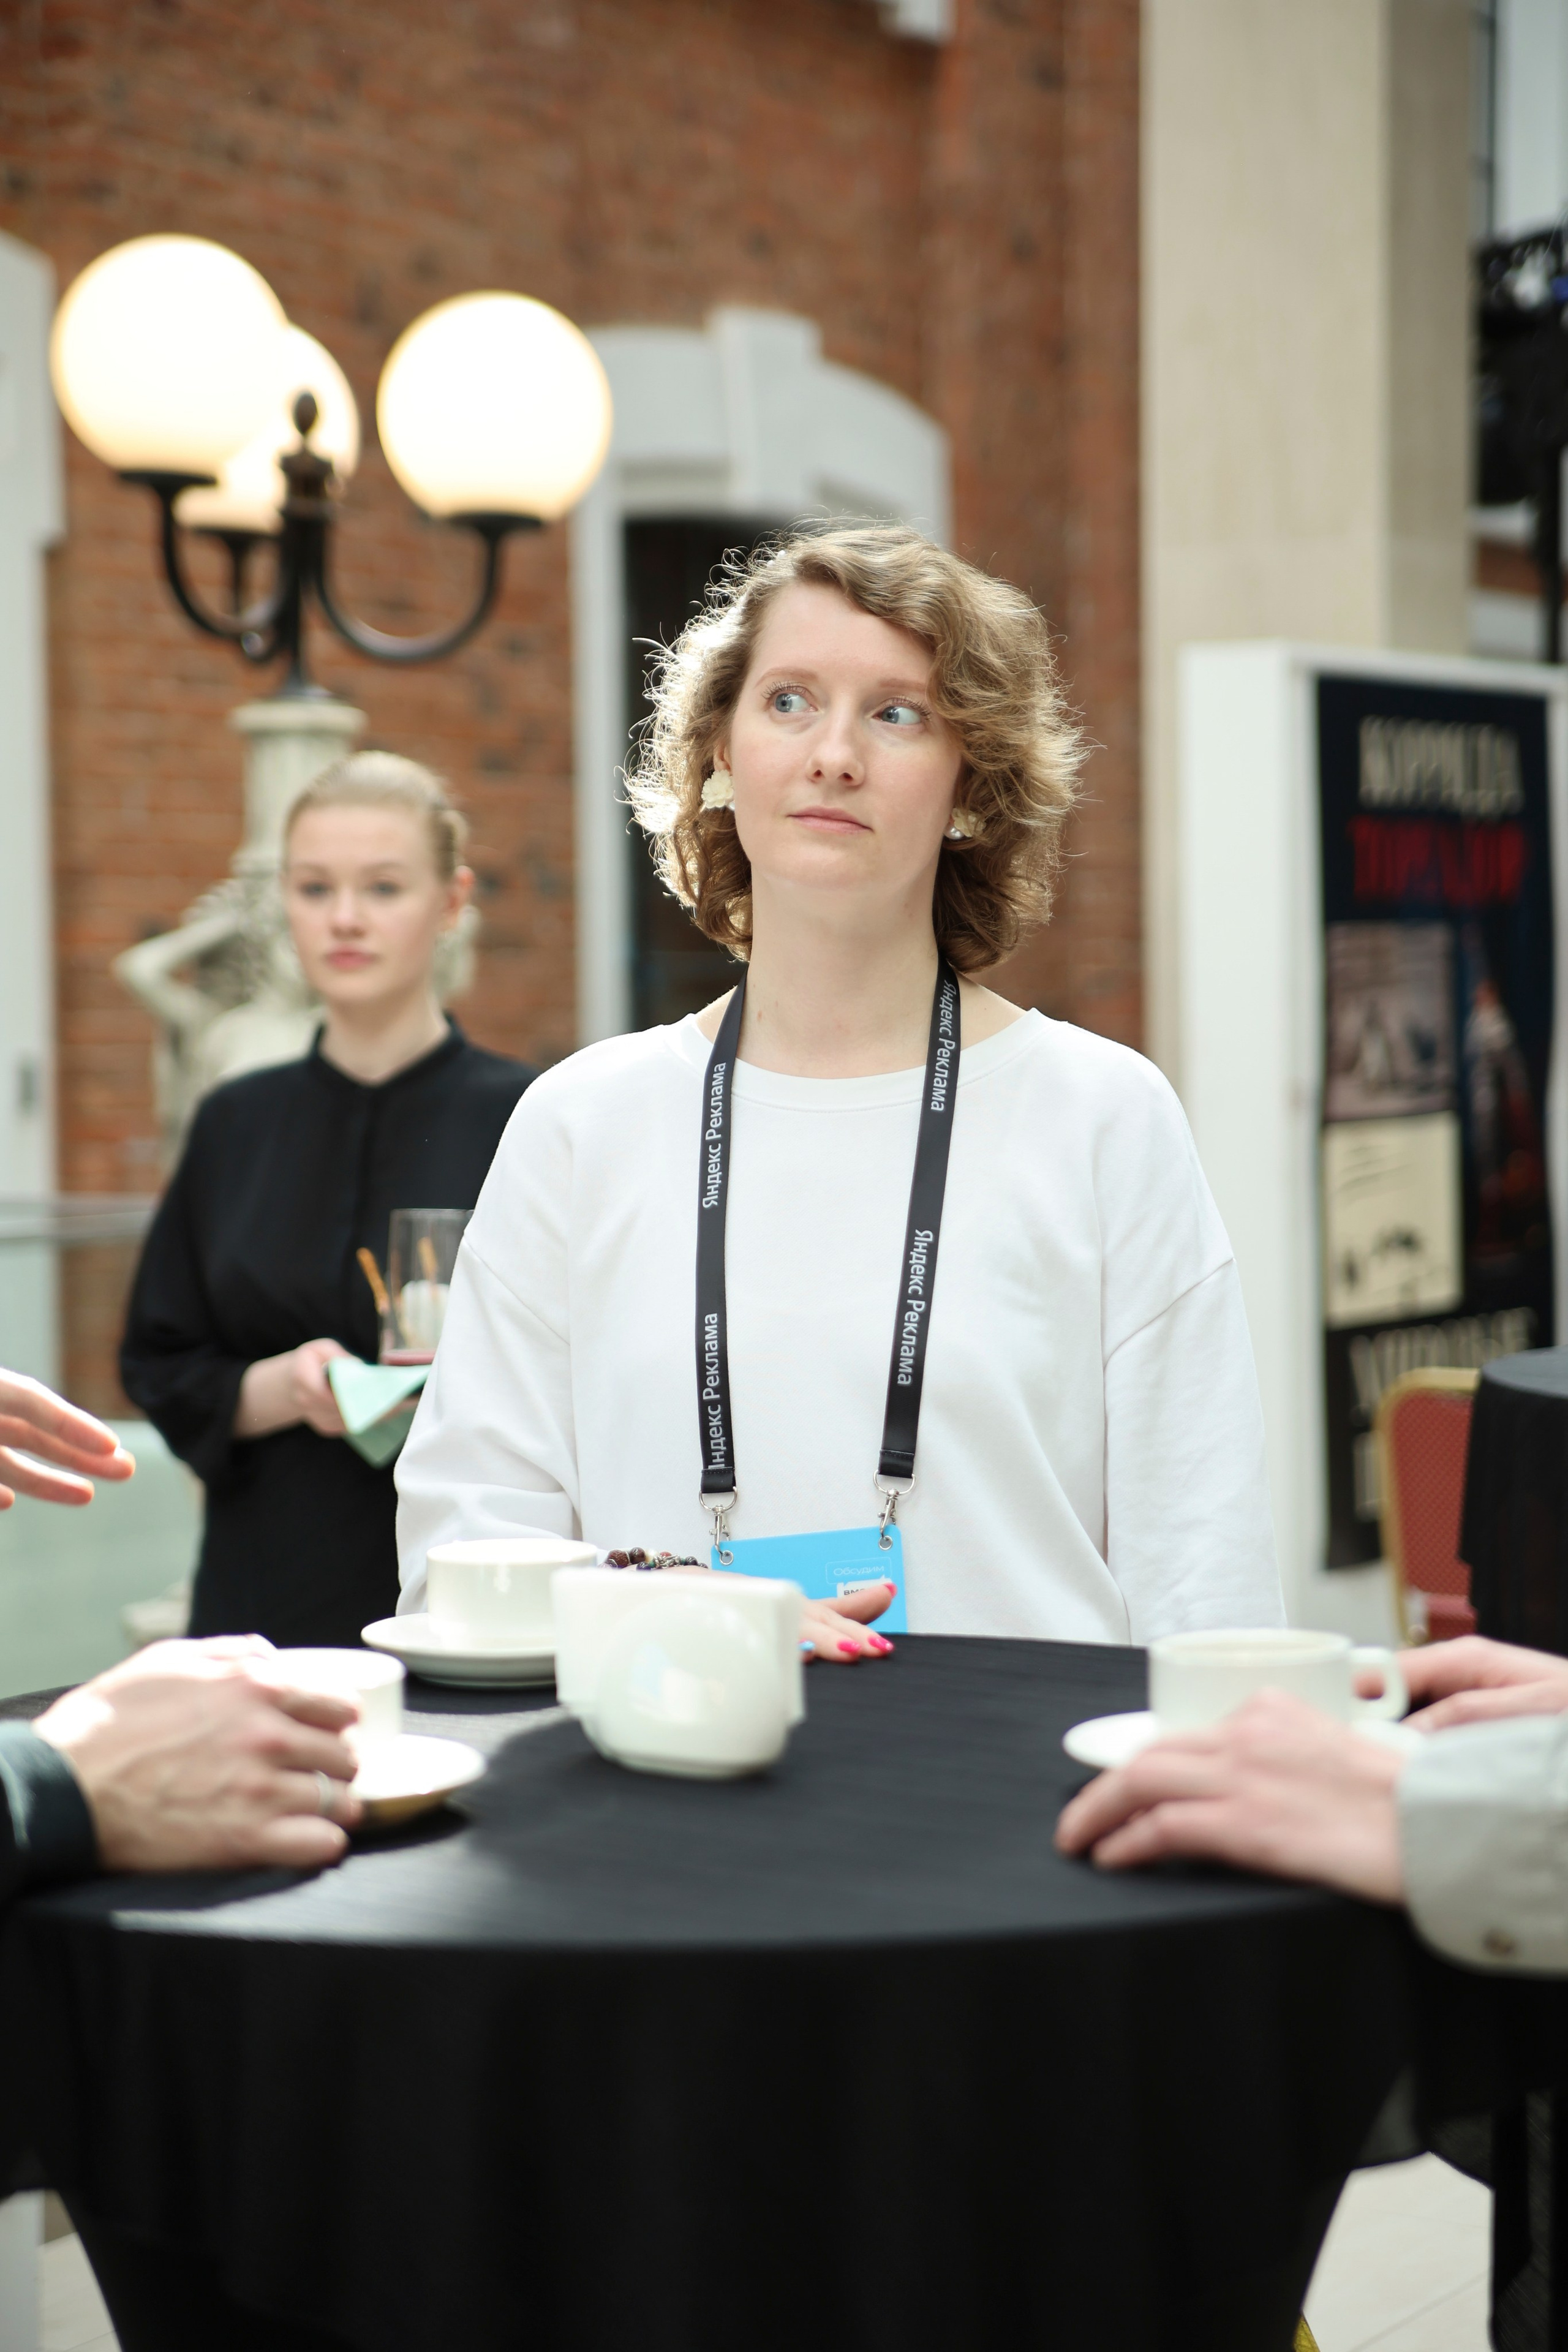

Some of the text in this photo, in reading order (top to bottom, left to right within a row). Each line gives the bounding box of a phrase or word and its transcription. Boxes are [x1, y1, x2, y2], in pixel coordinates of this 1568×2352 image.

[930, 979, 957, 1112] Яндекс Реклама
[702, 1062, 726, 1209] Яндекс Реклама
[703, 1313, 720, 1400] Реклама
[897, 1229, 933, 1385] Яндекс Реклама
[833, 1565, 884, 1576] Обсудим
